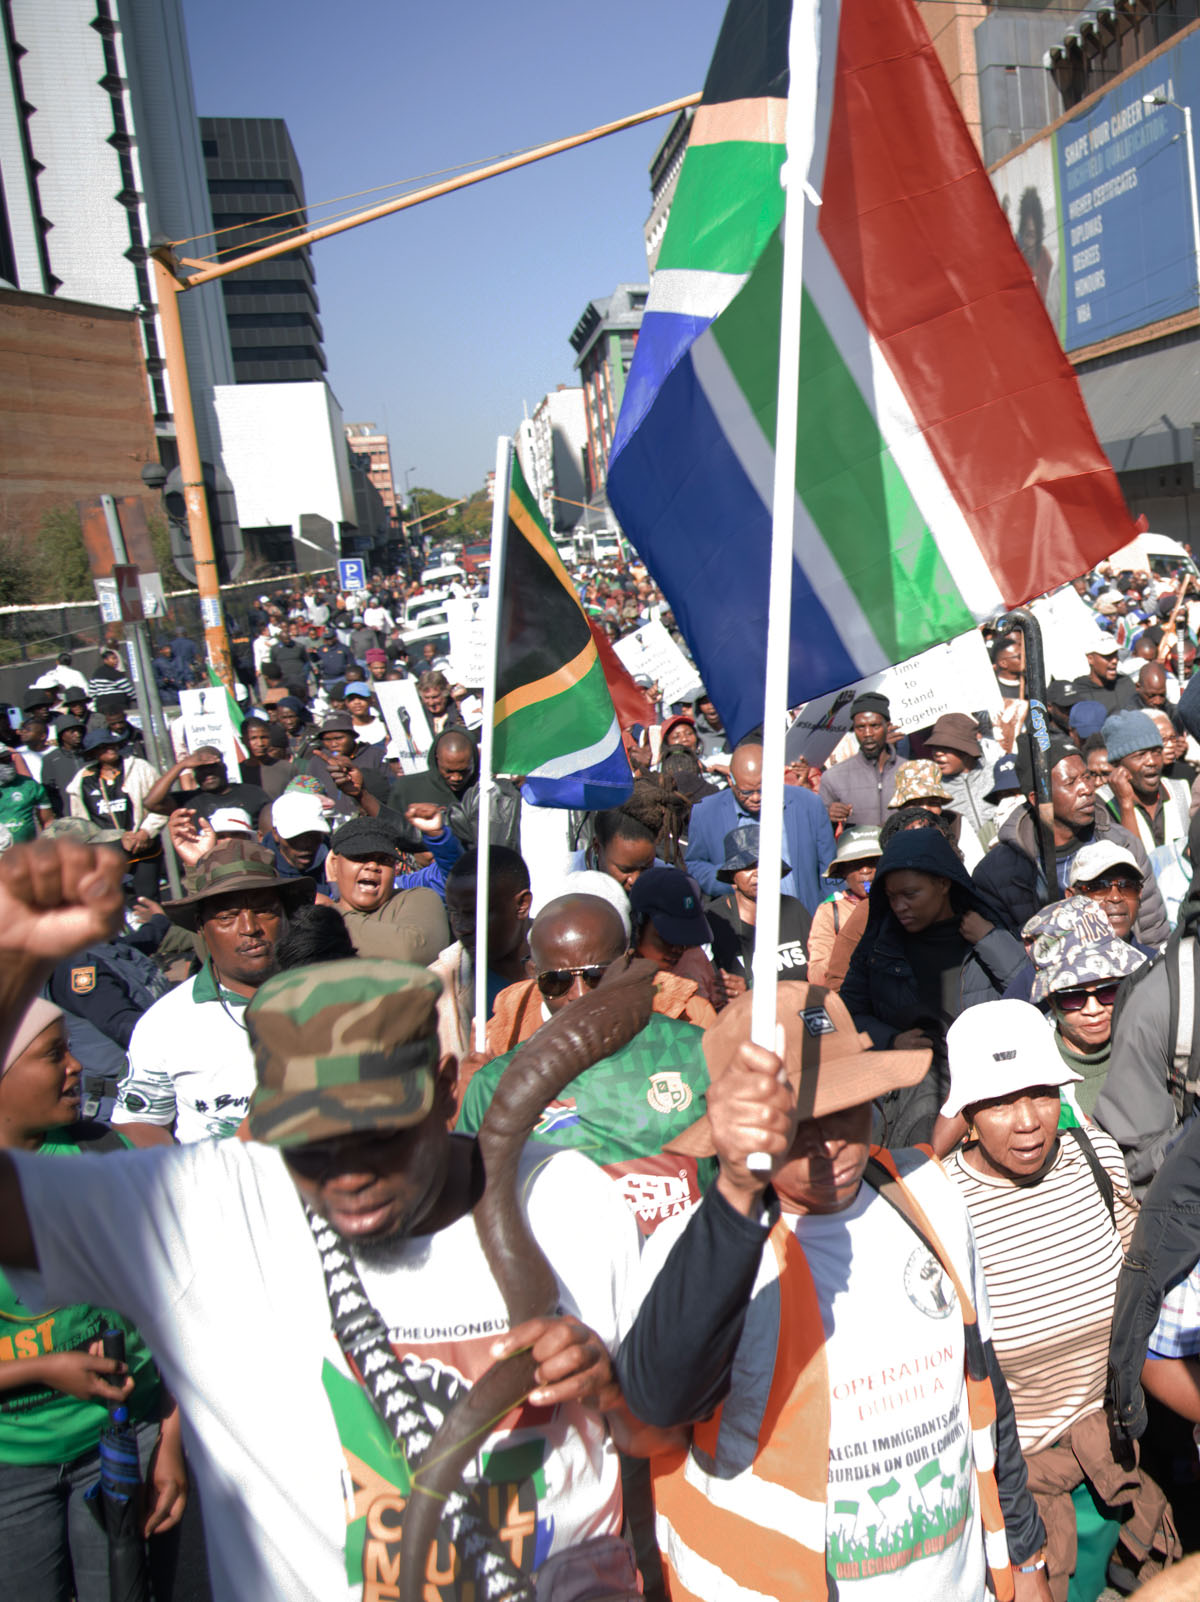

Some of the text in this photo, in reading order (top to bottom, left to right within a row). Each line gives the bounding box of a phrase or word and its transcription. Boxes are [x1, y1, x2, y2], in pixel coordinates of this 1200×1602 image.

[345, 563, 358, 577] P
[891, 661, 920, 677] Time
[904, 680, 917, 690] to
[901, 690, 935, 709] Stand
[898, 703, 949, 729] Together
[392, 1318, 510, 1341] THEUNIONBU
[832, 1345, 954, 1401] OPERATION
[872, 1413, 949, 1453] IMMIGRANTS
[884, 1455, 903, 1474] ON
[905, 1447, 930, 1466] OUR
[835, 1560, 860, 1579] OUR
[861, 1547, 913, 1577] ECONOMY
